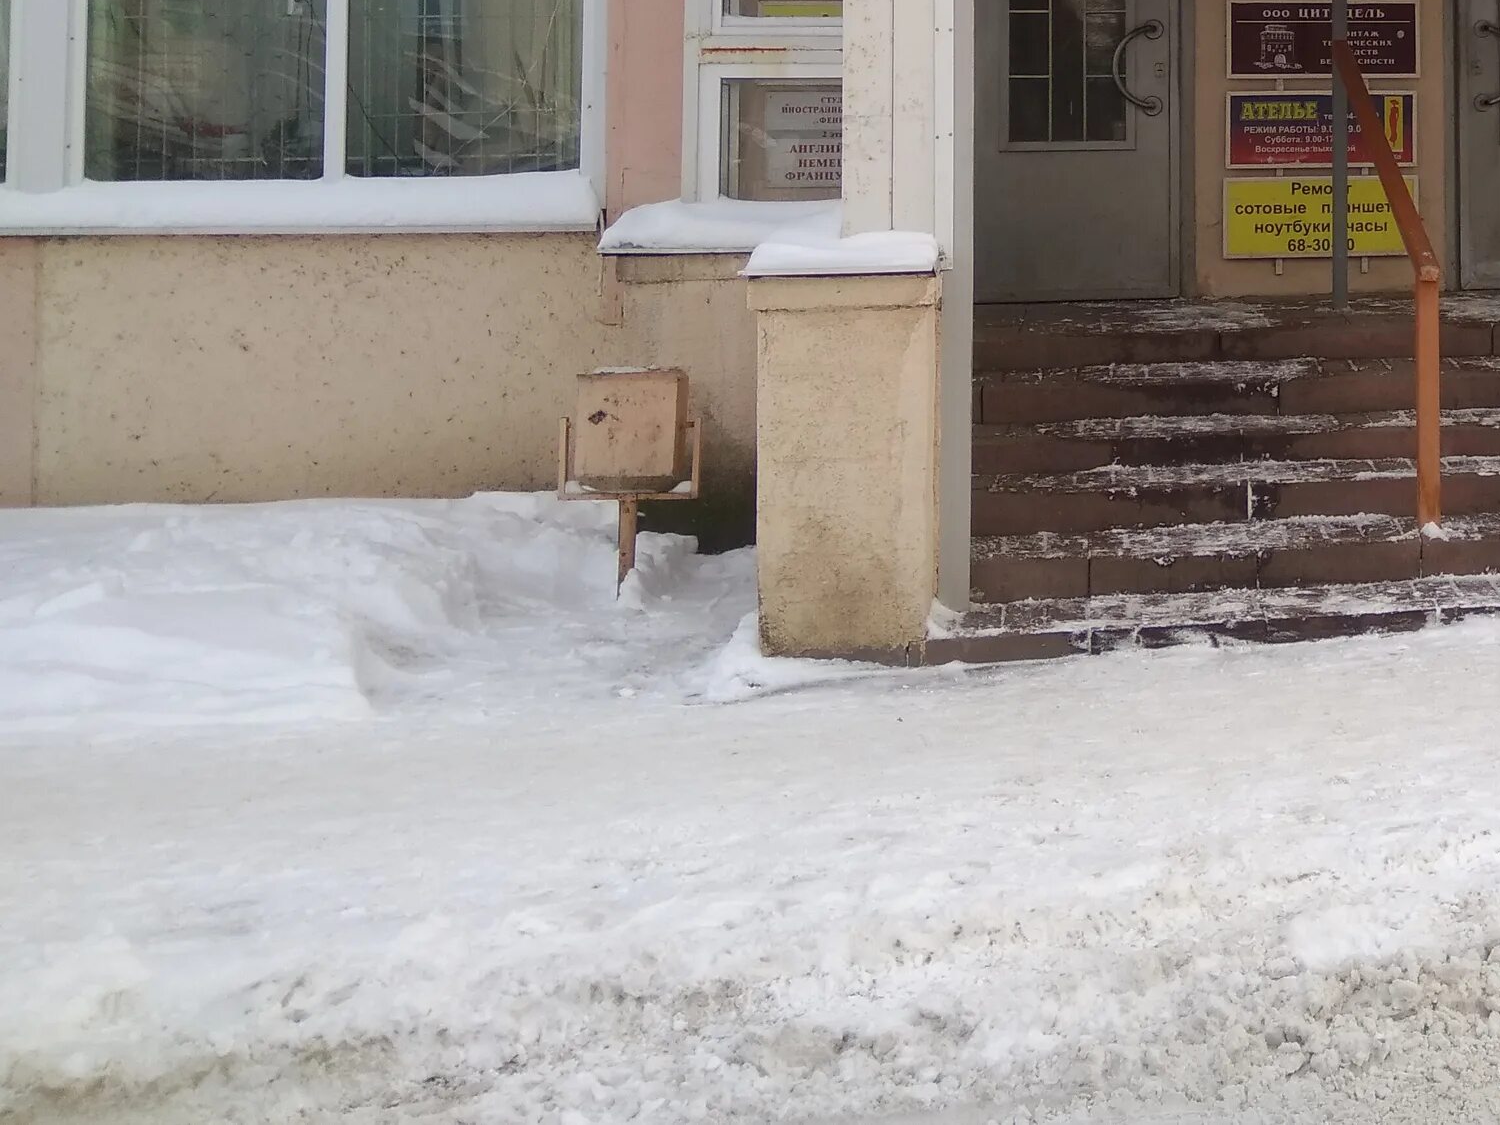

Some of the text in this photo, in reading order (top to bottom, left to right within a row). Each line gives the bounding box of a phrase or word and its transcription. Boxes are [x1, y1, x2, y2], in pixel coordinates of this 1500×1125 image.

[1299, 8, 1385, 20] ЦИТДЕЛЬ
[1346, 30, 1380, 38] НТАЖ
[1241, 101, 1318, 121] АТЕЛЬЕ
[1244, 125, 1275, 133] РЕЖИМ
[785, 171, 842, 181] ФРАНЦУ
[1291, 181, 1351, 195] Ремот
[1234, 203, 1306, 215] сотовые
[1254, 219, 1388, 236] ноутбуки часы
